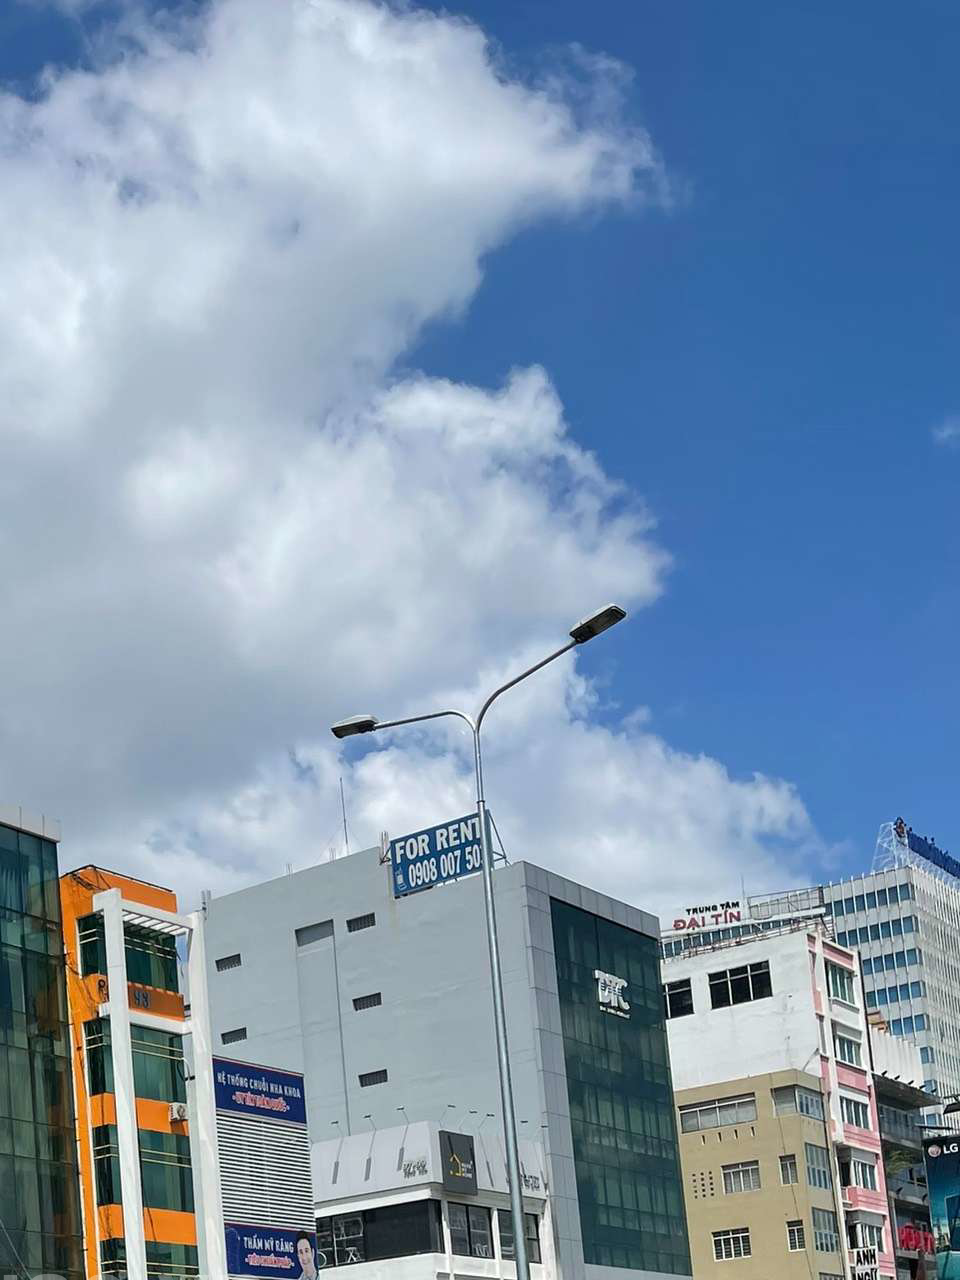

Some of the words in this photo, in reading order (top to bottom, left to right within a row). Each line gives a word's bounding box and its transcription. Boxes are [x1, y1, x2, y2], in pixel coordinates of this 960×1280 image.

[395, 834, 430, 864] FOR
[435, 817, 481, 851] RENT
[408, 857, 438, 888] 0908
[440, 849, 461, 878] 007
[465, 843, 483, 870] 50
[686, 904, 718, 916] TRUNG
[720, 900, 740, 911] TÂM
[673, 916, 706, 931] ĐẠI
[711, 909, 741, 926] TÍN
[943, 1143, 959, 1155] LG
[856, 1248, 877, 1266] ANH
